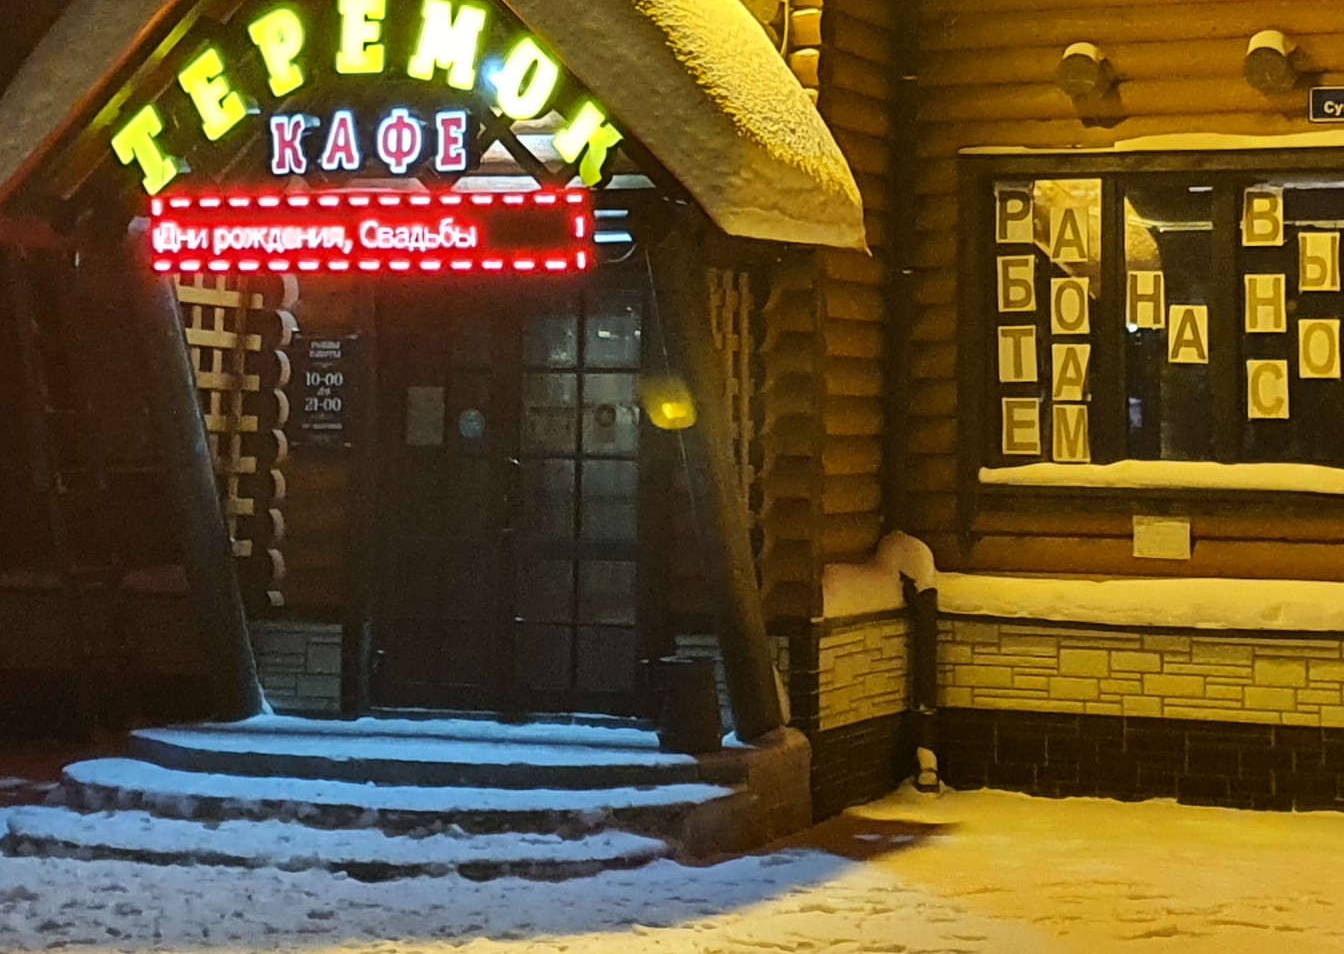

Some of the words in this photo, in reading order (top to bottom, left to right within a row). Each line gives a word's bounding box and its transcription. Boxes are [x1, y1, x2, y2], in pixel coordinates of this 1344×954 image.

[270, 108, 467, 175] КАФЕ
[157, 221, 205, 252] Дни
[213, 225, 353, 255] рождения,
[359, 217, 477, 252] Свадьбы
[305, 371, 344, 386] 10-00
[304, 397, 342, 412] 21-00
